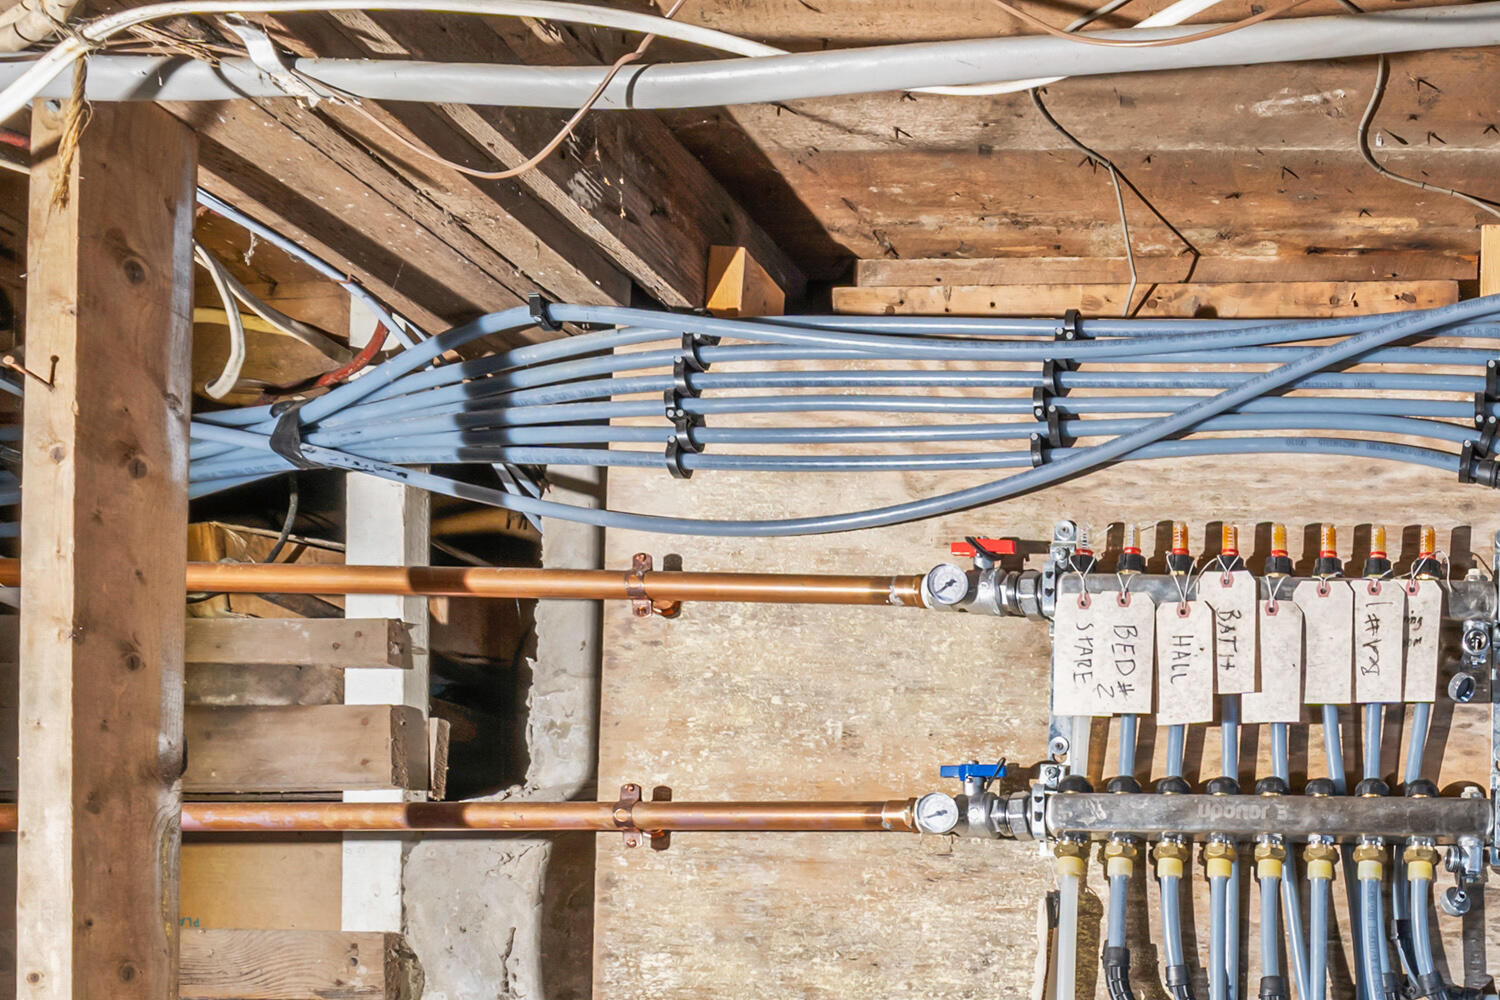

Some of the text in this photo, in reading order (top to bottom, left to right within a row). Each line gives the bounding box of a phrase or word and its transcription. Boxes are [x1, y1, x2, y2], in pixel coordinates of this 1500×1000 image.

[1170, 635, 1194, 685] HALL
[1216, 608, 1242, 671] BATH
[1198, 804, 1270, 822] uponor
